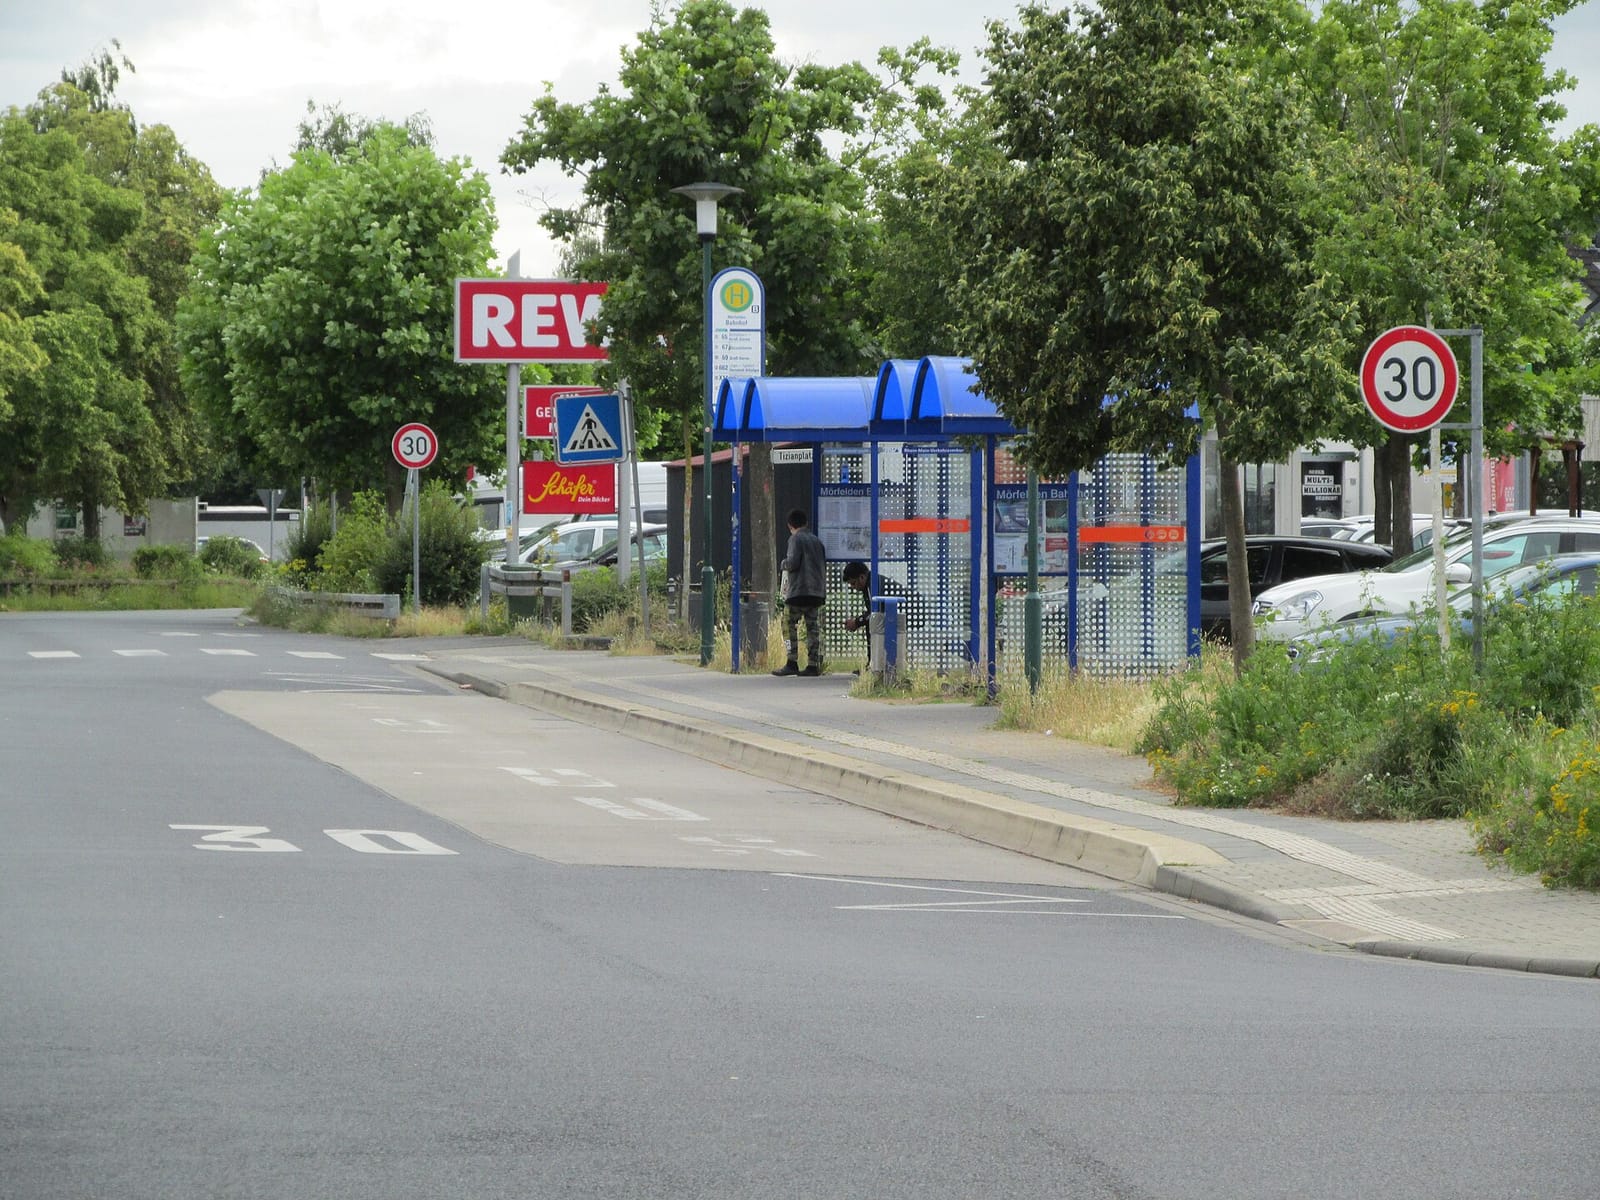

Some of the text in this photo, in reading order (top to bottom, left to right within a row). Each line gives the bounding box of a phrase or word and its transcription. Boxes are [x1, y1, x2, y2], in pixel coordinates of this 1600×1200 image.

[1383, 356, 1437, 402] 30
[402, 436, 428, 456] 30
[779, 451, 813, 462] Tizianplat
[527, 471, 596, 503] Schäfer
[996, 489, 1048, 499] Mörfeln
